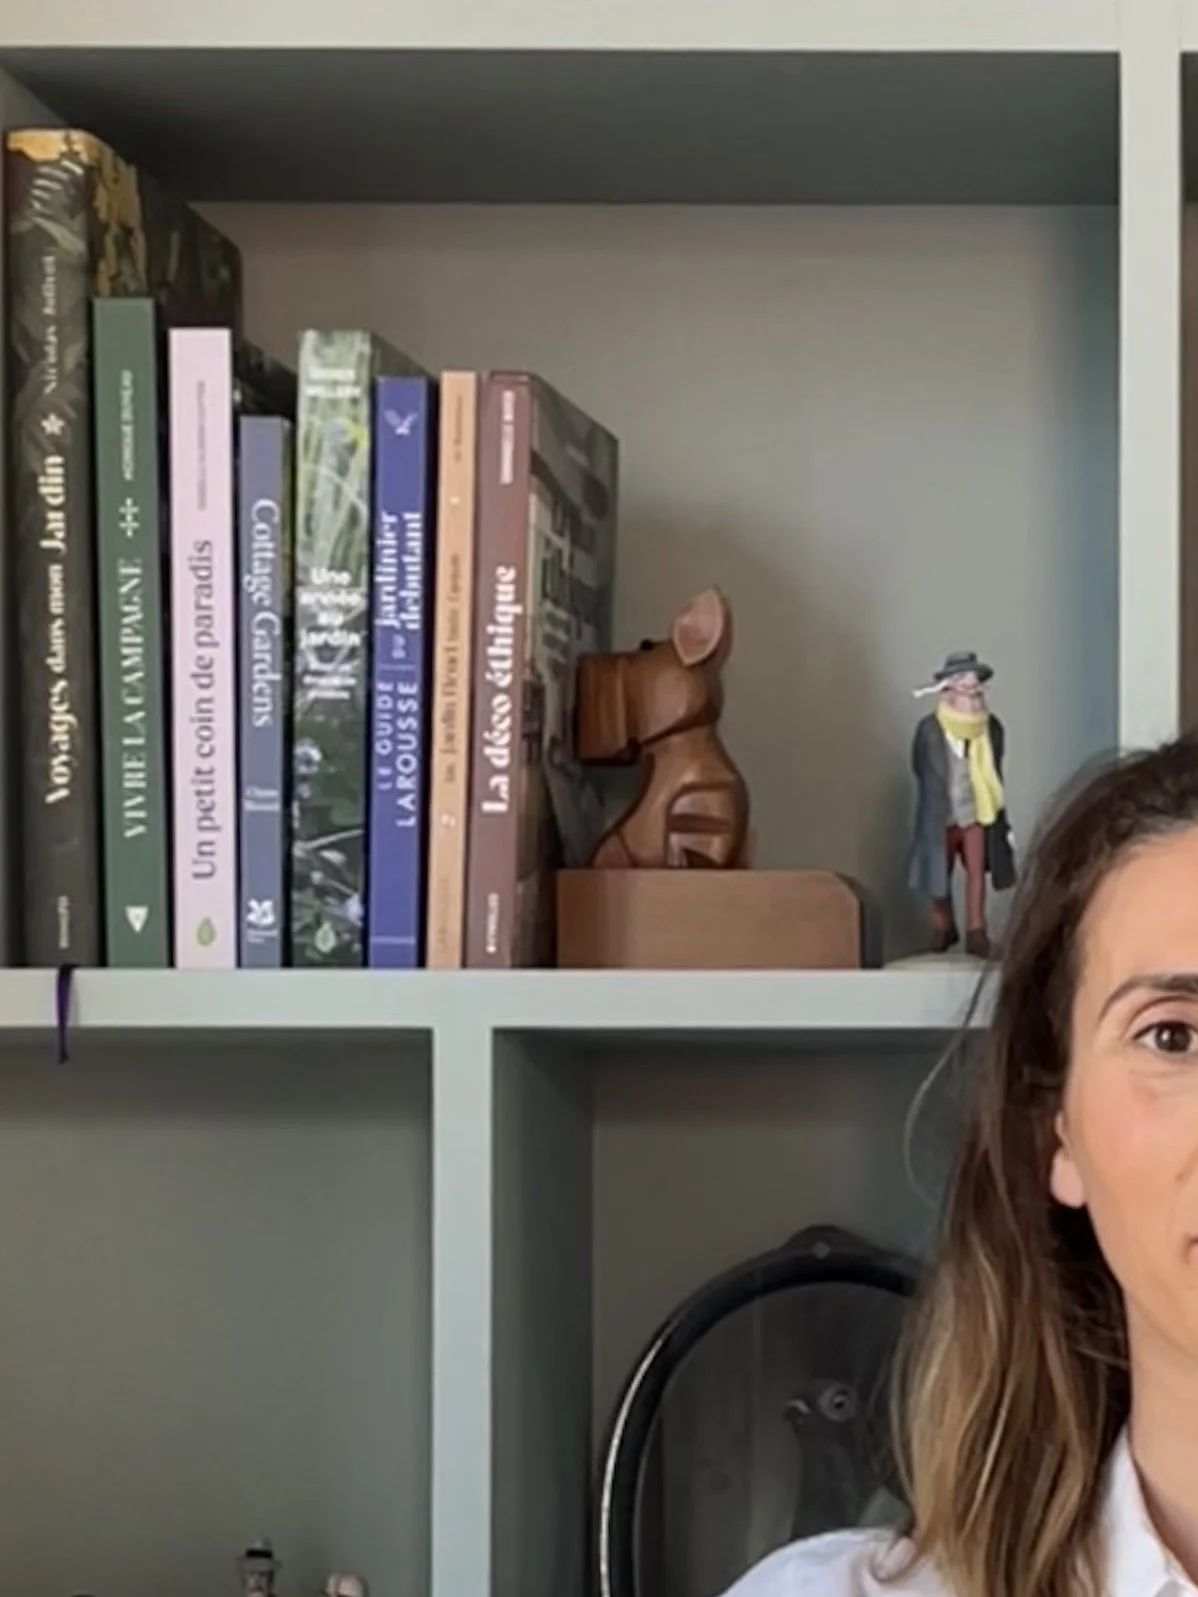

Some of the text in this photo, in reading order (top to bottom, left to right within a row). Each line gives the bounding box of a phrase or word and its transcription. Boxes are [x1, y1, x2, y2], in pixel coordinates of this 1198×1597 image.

[37, 454, 66, 555] Jardin
[48, 563, 65, 614] mon
[243, 498, 282, 728] Cottage Gardens
[375, 511, 399, 629] jardinier
[45, 617, 66, 673] dans
[117, 557, 146, 706] CAMPAGNE
[481, 565, 523, 813] La déco éthique
[45, 679, 77, 803] Voyages
[121, 711, 147, 745] LA
[187, 538, 222, 880] Un petit coin de paradis
[375, 681, 395, 757] GUIDE
[396, 680, 419, 828] LAROUSSE
[122, 751, 148, 838] VIVRE
